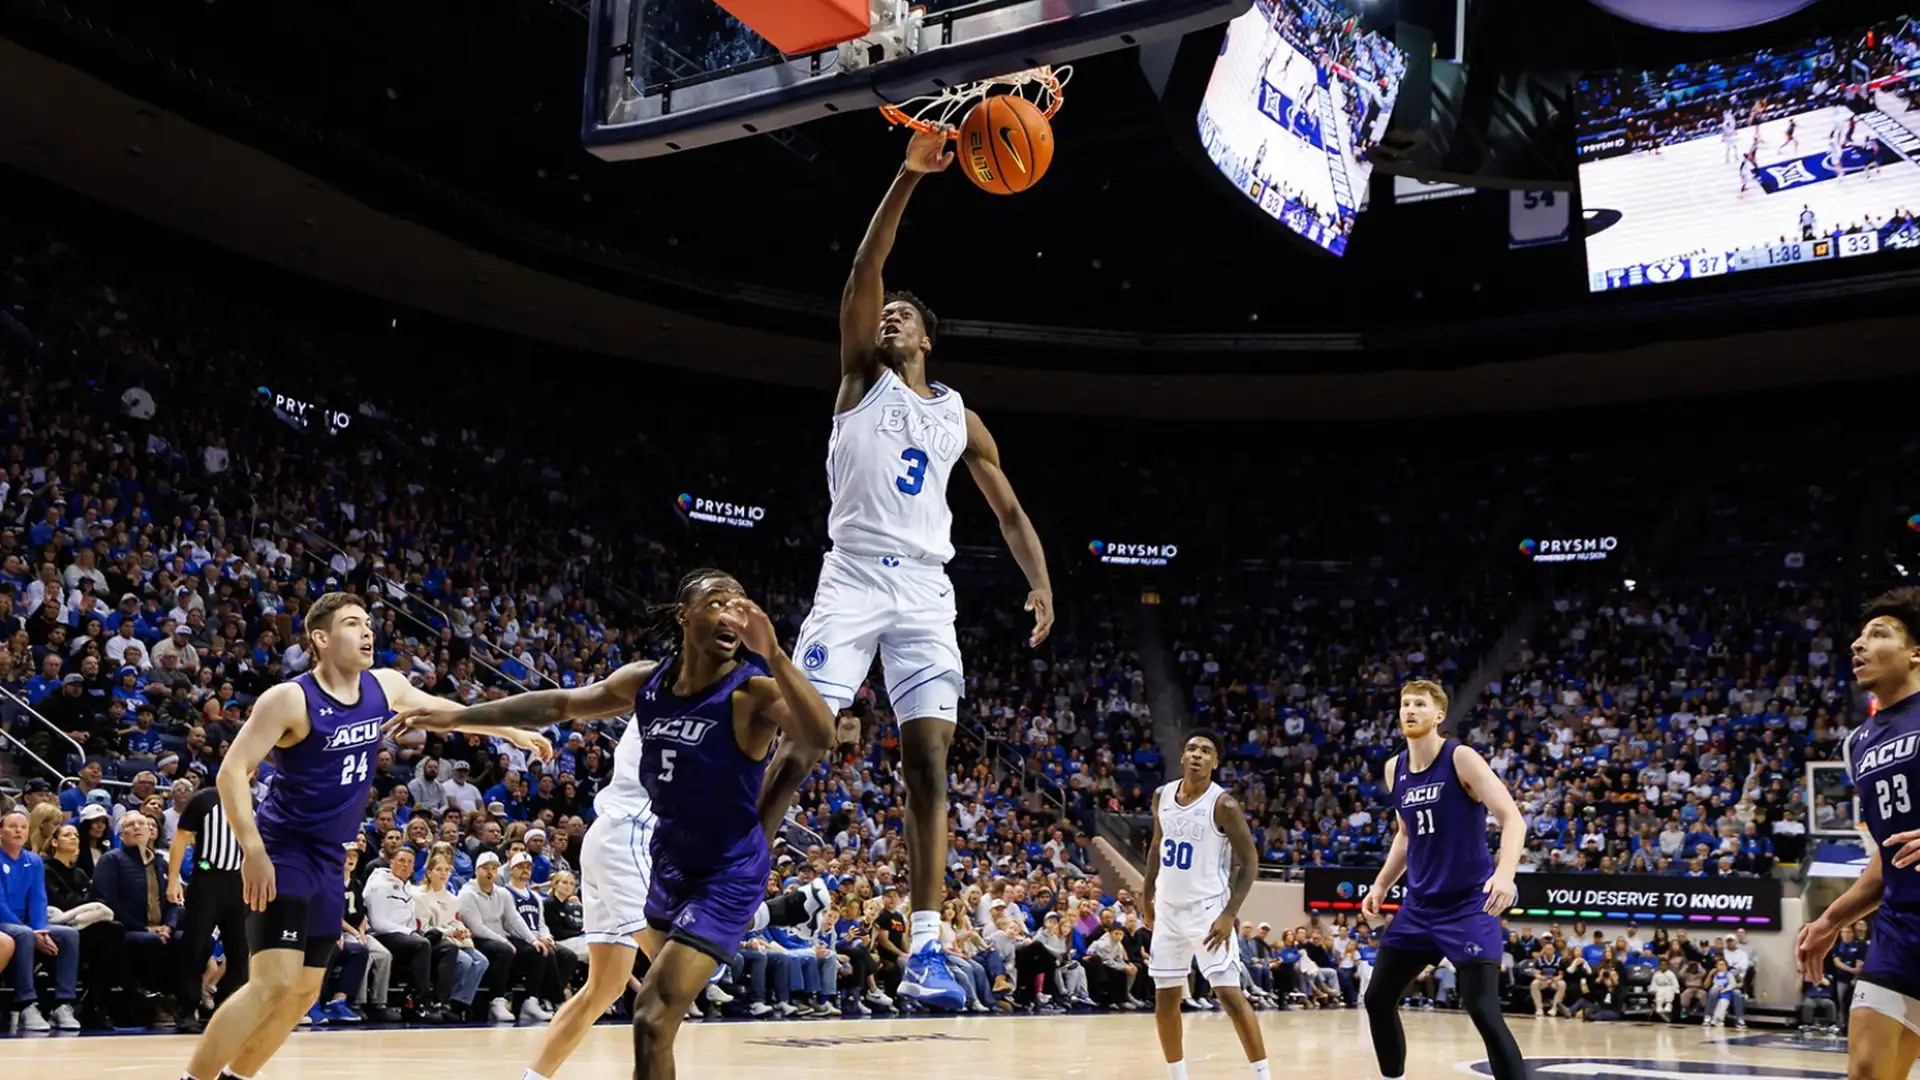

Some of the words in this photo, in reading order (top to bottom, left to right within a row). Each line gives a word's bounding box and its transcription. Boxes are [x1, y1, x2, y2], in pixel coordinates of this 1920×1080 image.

[971, 131, 994, 182] ELITE
[1768, 244, 1801, 264] 1:38
[1848, 235, 1870, 252] 33
[1699, 257, 1719, 274] 37
[876, 402, 958, 462] BYU
[896, 447, 929, 496] 3
[695, 497, 745, 517] PRYSM
[1107, 542, 1158, 556] PRYSM
[1540, 539, 1596, 553] PRYSM
[330, 721, 379, 748] ACU
[647, 720, 706, 741] ACU
[340, 750, 368, 786] 24
[658, 749, 677, 782] 5
[1859, 735, 1917, 774] ACU
[1404, 786, 1438, 804] ACU
[1875, 773, 1911, 820] 23
[1416, 808, 1435, 835] 21
[1162, 838, 1194, 870] 30
[1546, 889, 1581, 905] YOU
[1584, 890, 1660, 908] DESERVE
[1663, 892, 1687, 908] TO
[1689, 893, 1754, 911] KNOW!
